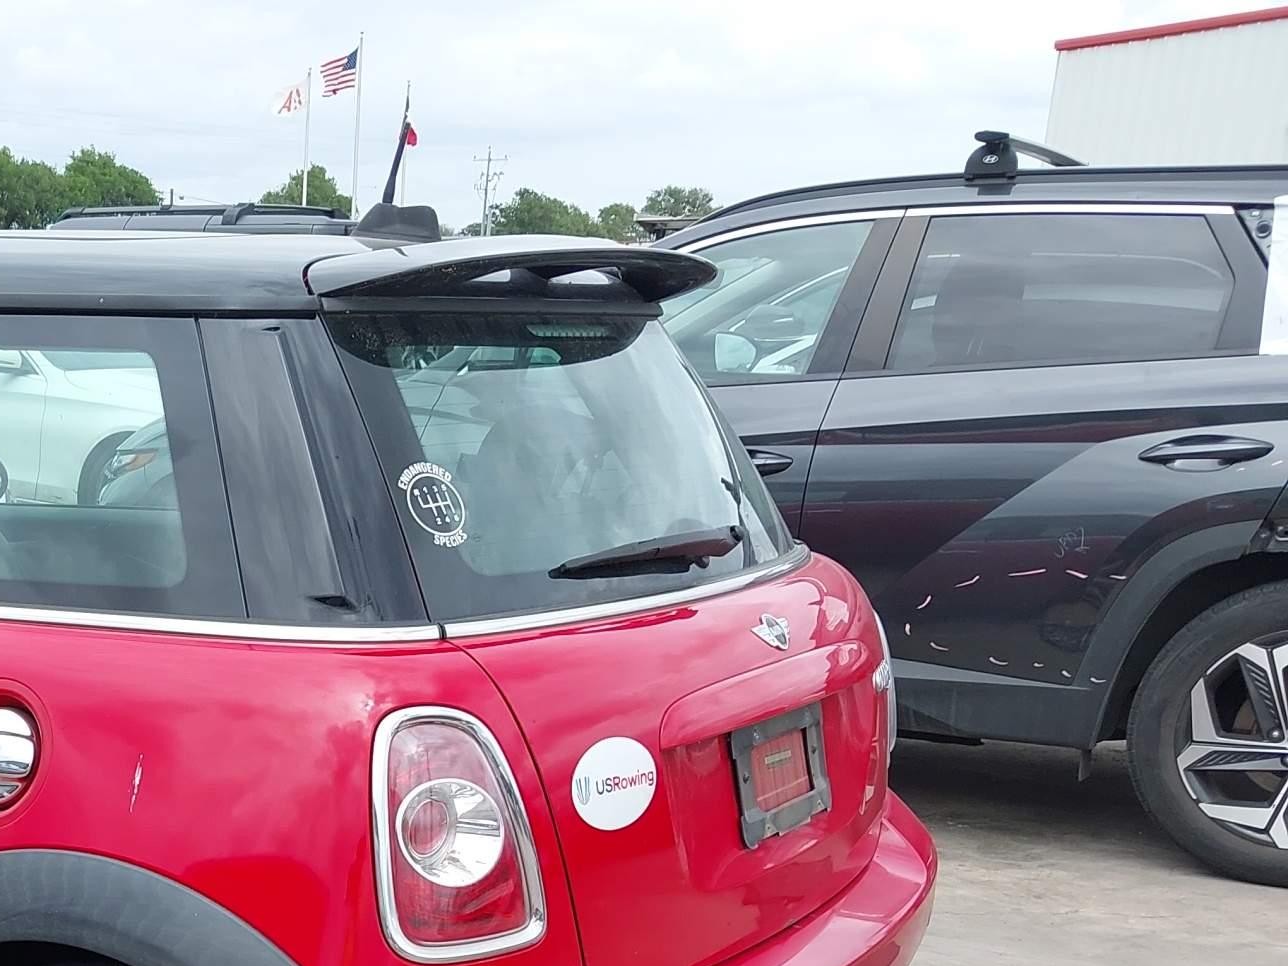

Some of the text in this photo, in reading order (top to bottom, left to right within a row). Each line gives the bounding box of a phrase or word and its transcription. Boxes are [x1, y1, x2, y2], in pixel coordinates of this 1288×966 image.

[398, 462, 452, 490] ENDANGERED
[433, 529, 468, 548] SPECIES
[596, 769, 655, 796] USRowing
